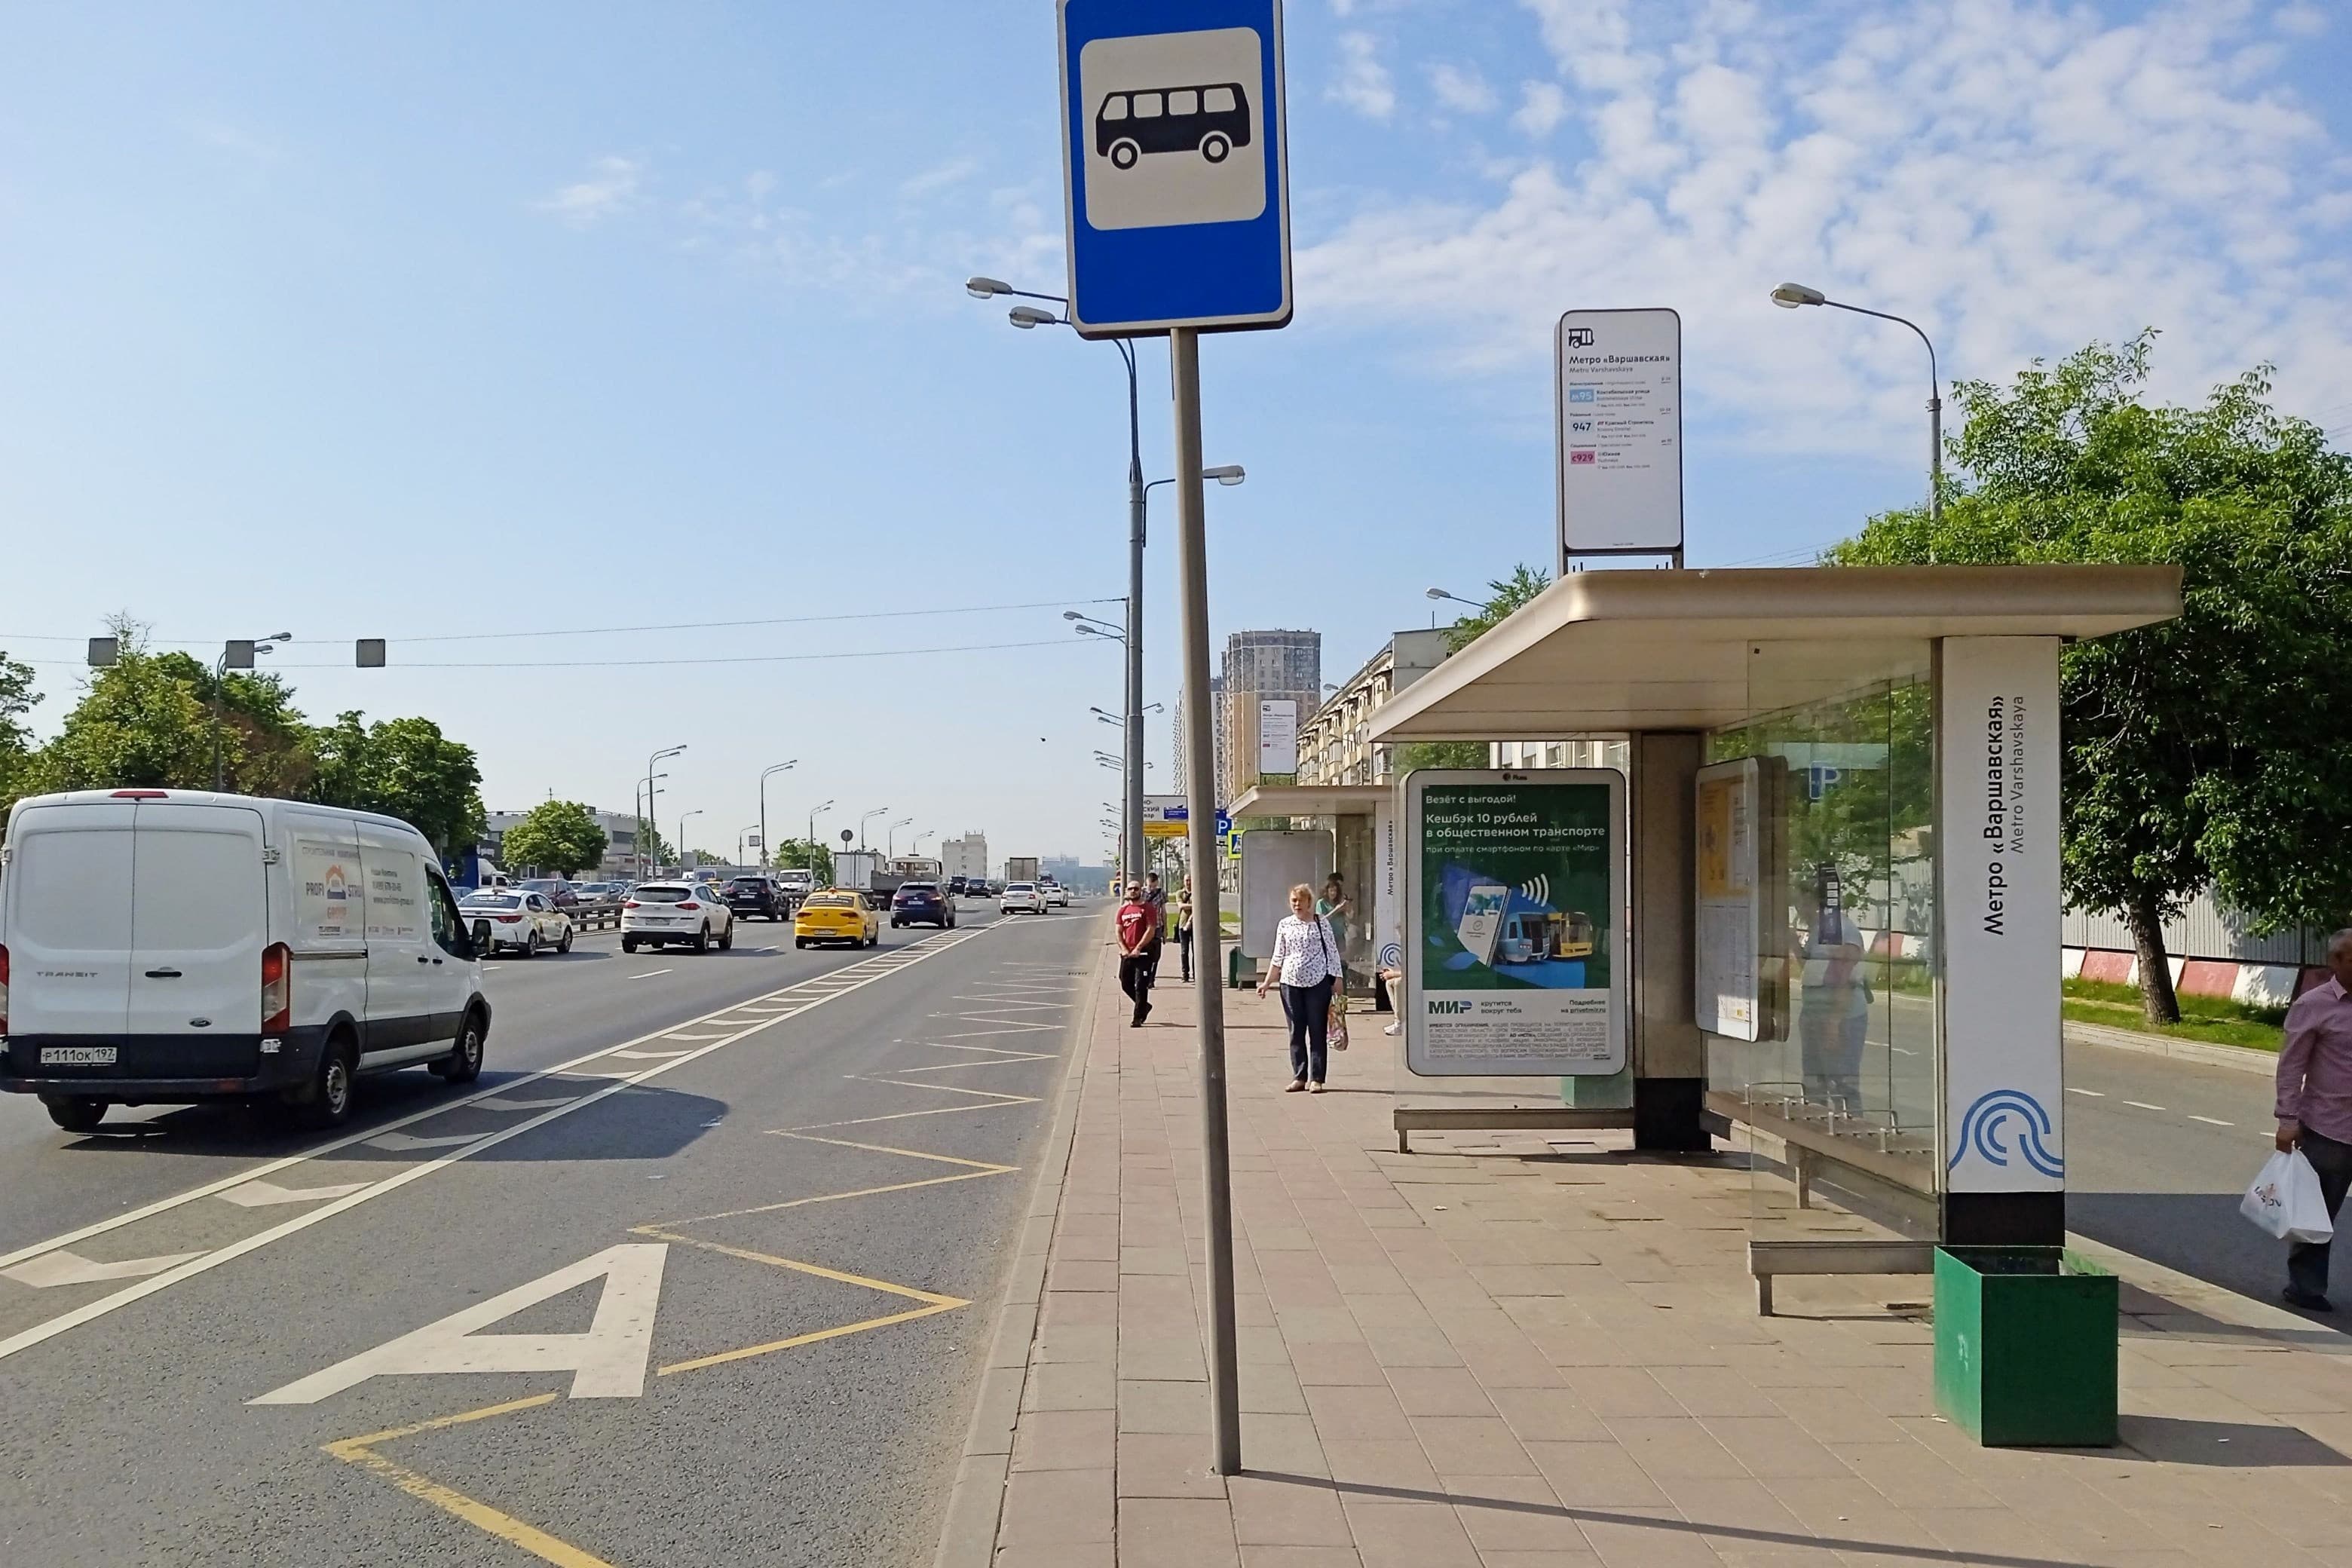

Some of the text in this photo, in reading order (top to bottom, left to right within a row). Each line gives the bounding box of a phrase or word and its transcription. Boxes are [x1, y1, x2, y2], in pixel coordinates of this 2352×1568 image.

[1569, 355, 1671, 365] Метро «Варшавская»
[1573, 422, 1592, 432] 947
[2010, 696, 2027, 854] Metro Varshavskaya
[1426, 795, 1456, 804] Везёт
[1468, 794, 1517, 805] выгодой!
[1426, 813, 1537, 825] Кешбэк 10 рублей
[1983, 695, 2007, 936] Метро «Варшавская»
[1217, 820, 1229, 834] P
[1436, 828, 1530, 838] общественном
[1533, 827, 1605, 838] транспорте
[1476, 844, 1531, 853] смартфоном
[1573, 844, 1600, 853] «Мир»
[305, 882, 324, 897] PROFI
[1429, 1000, 1472, 1015] МИР
[94, 1048, 114, 1058] 197
